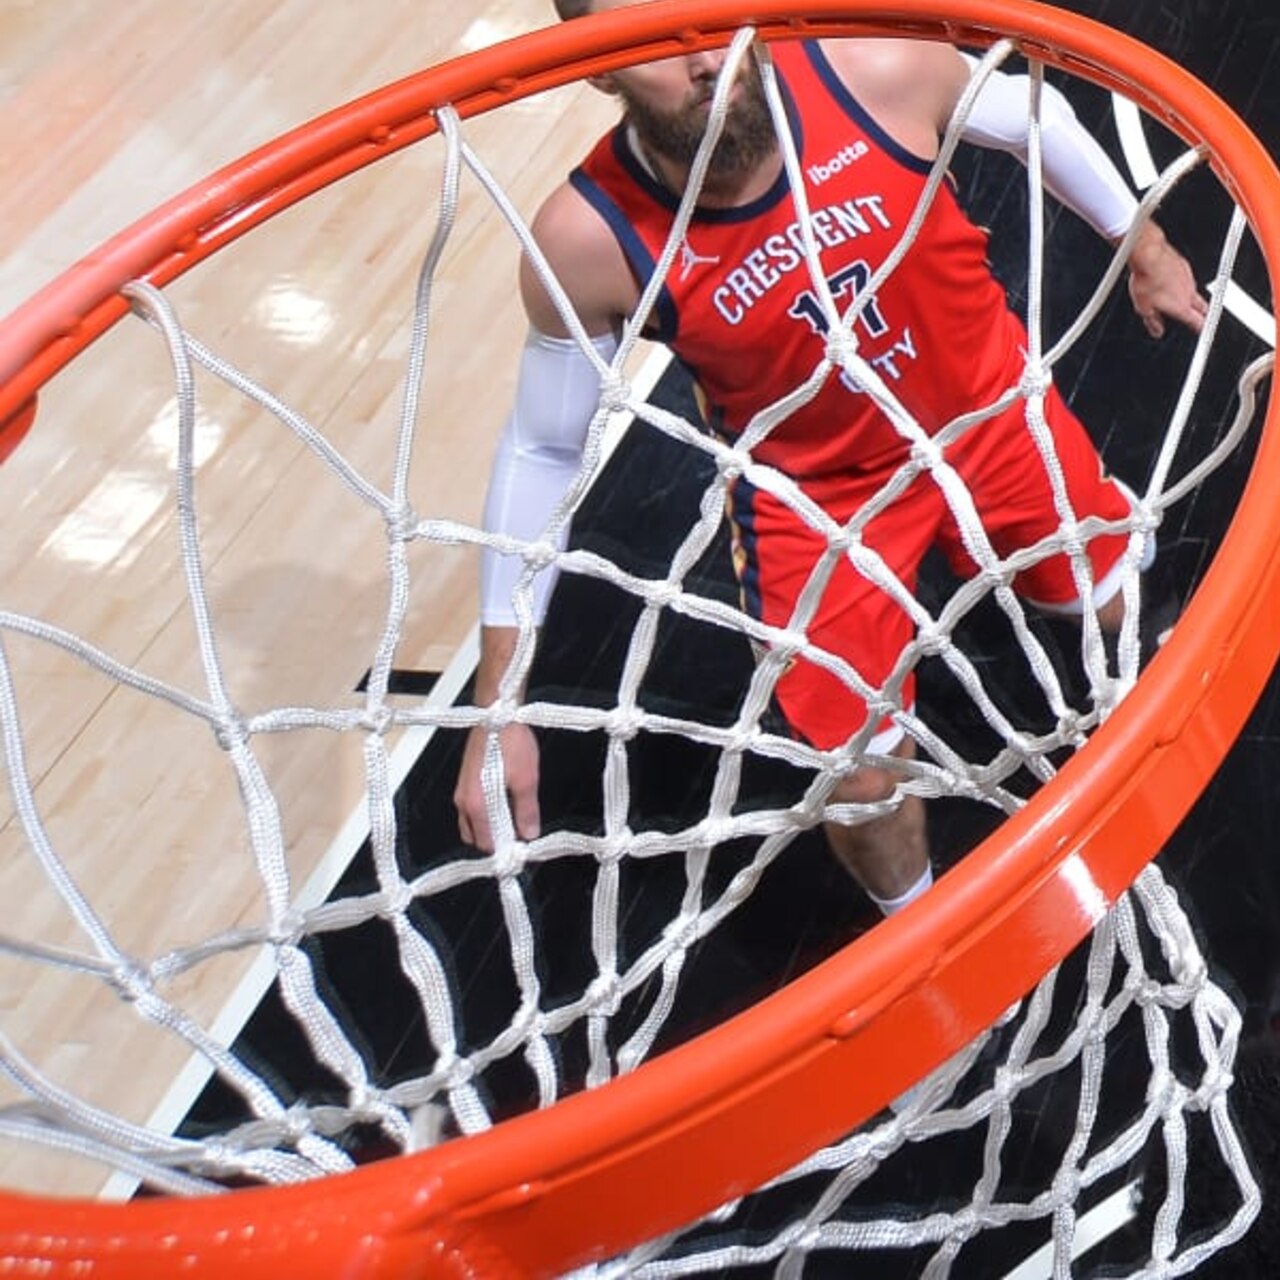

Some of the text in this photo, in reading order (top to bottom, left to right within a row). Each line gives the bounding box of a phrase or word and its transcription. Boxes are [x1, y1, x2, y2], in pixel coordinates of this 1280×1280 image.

[806, 139, 869, 187] ibotta
[713, 195, 892, 325] CRESCENT
[788, 259, 889, 338] 17
